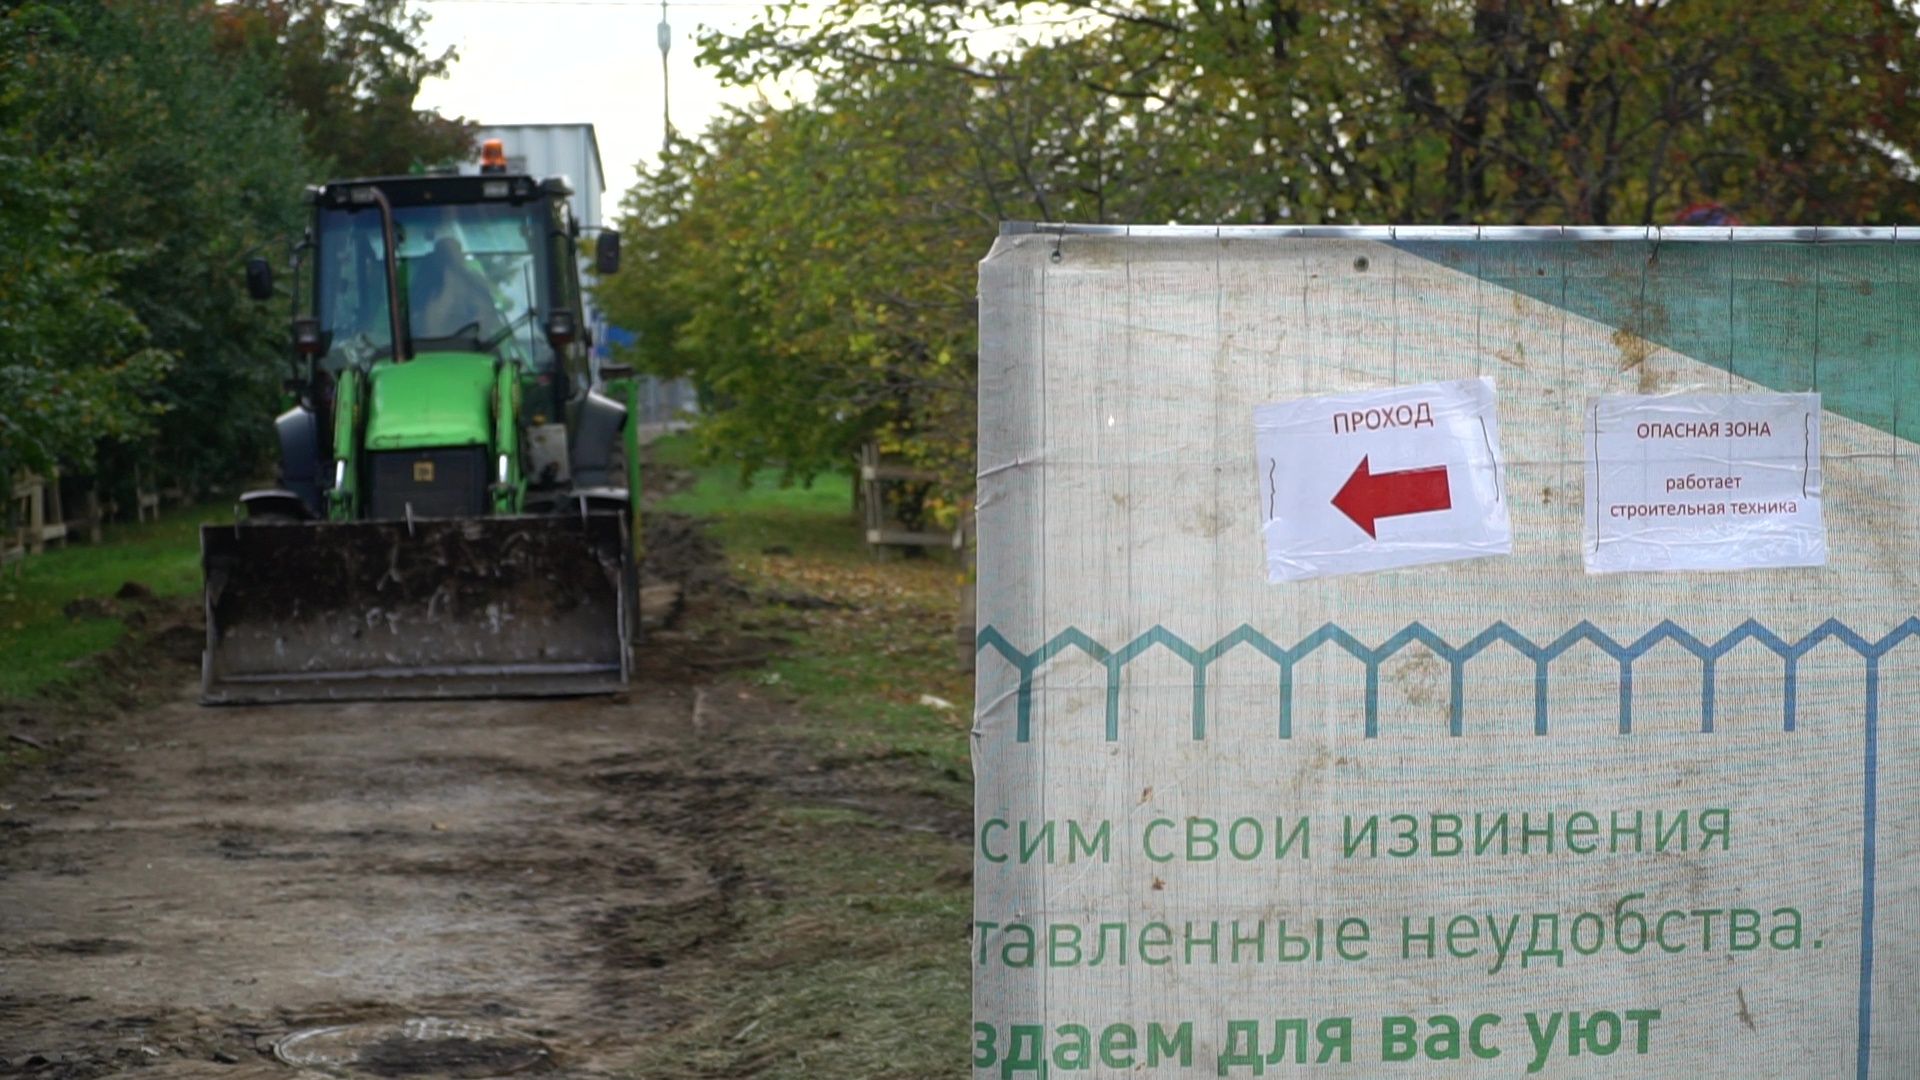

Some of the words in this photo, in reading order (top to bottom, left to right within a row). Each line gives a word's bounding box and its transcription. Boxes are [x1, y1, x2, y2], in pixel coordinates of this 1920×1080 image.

[1333, 402, 1434, 434] ПРОХОД
[1637, 421, 1720, 439] ОПАСНАЯ
[1724, 421, 1771, 438] ЗОНА
[1665, 476, 1742, 493] работает
[1610, 501, 1726, 518] строительная
[1729, 499, 1797, 516] техника
[981, 818, 1111, 863] сим
[1143, 816, 1311, 862] свои
[1343, 808, 1731, 858] извинения
[975, 916, 1370, 968] тавленные
[1401, 893, 1823, 974] неудобства.
[975, 1020, 1194, 1080] здаем
[1218, 1017, 1353, 1076] для
[1381, 1013, 1502, 1062] вас
[1524, 1009, 1661, 1073] уют
